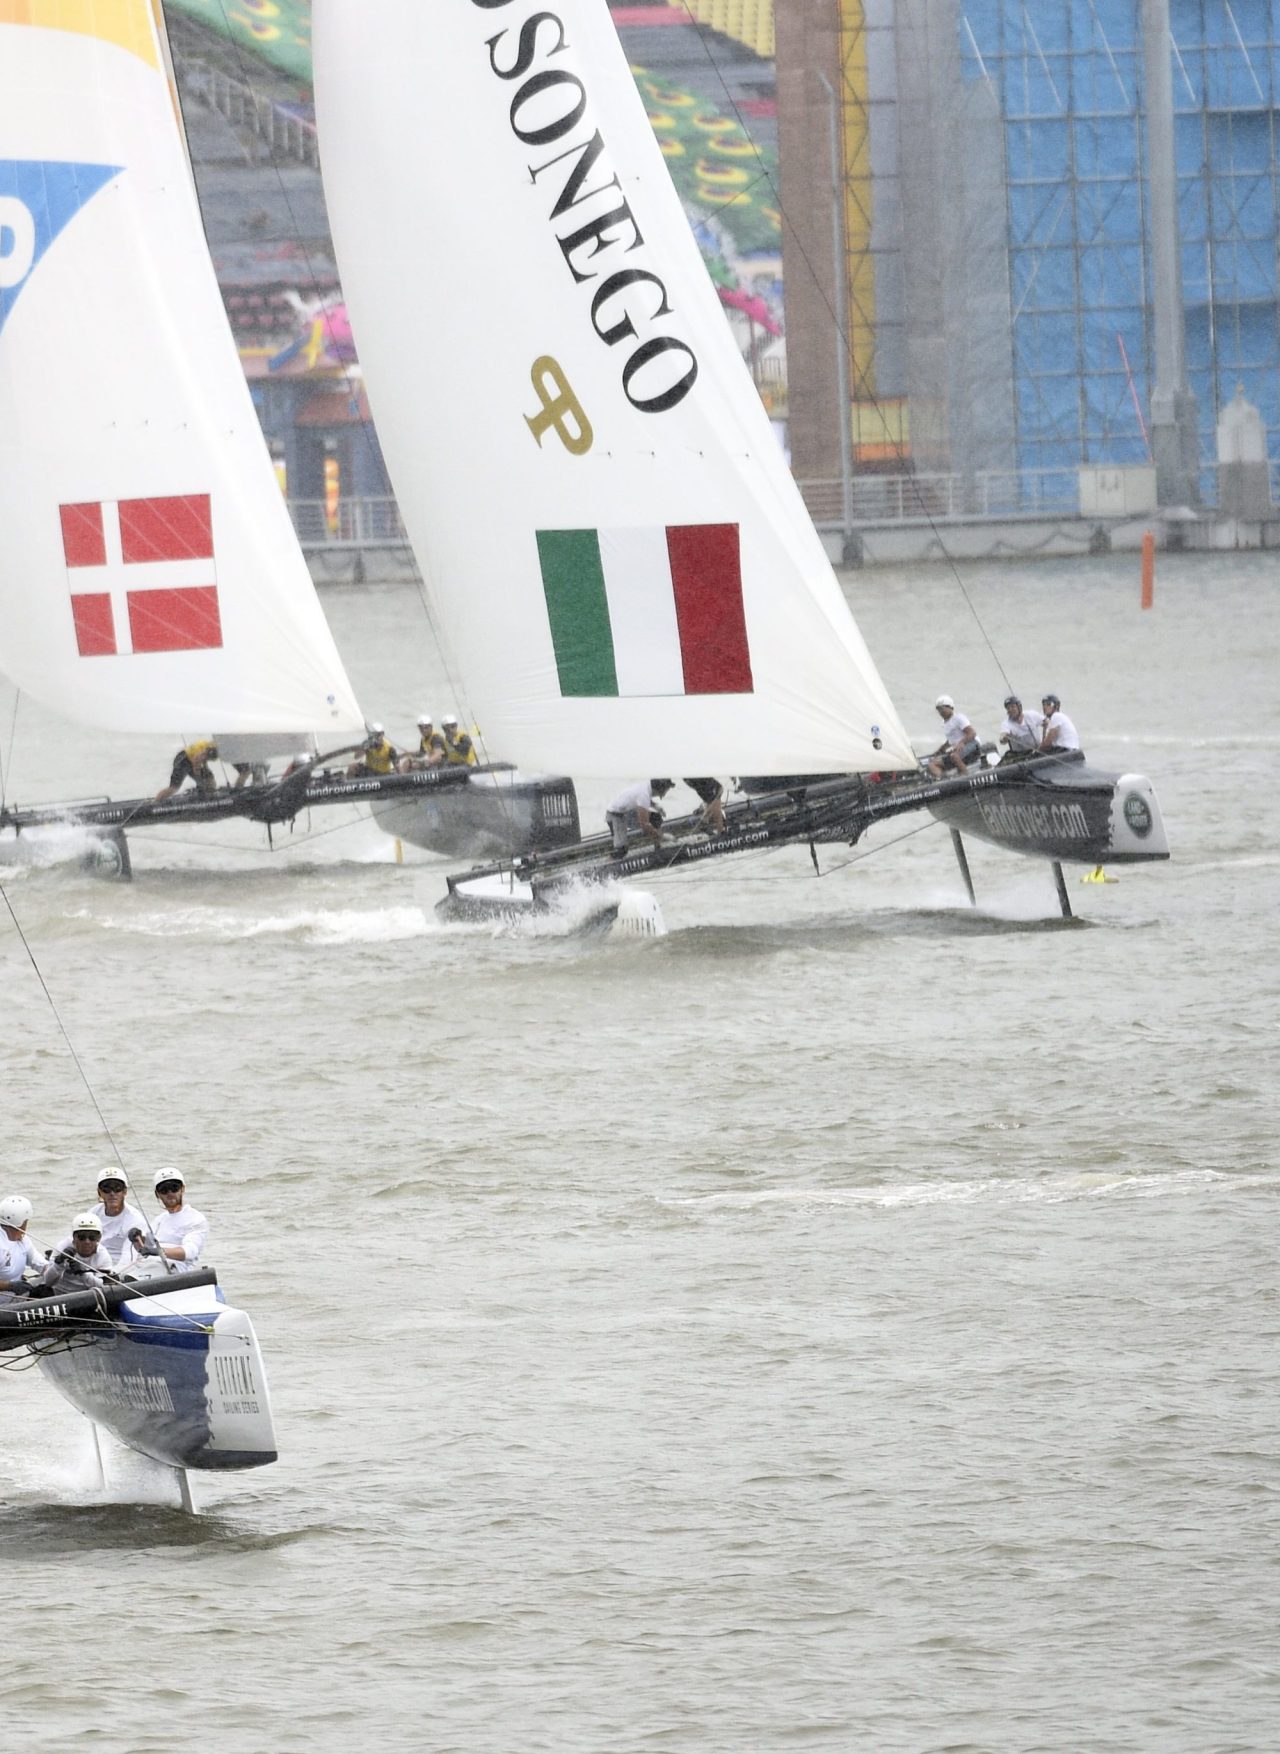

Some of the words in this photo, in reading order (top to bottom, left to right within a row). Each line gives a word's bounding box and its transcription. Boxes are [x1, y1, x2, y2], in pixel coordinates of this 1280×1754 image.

[472, 0, 698, 413] SONEGO
[306, 780, 381, 798] landrover.com
[974, 790, 1091, 839] landrover.com
[686, 829, 770, 858] landrover.com
[16, 1303, 69, 1323] EXTREME
